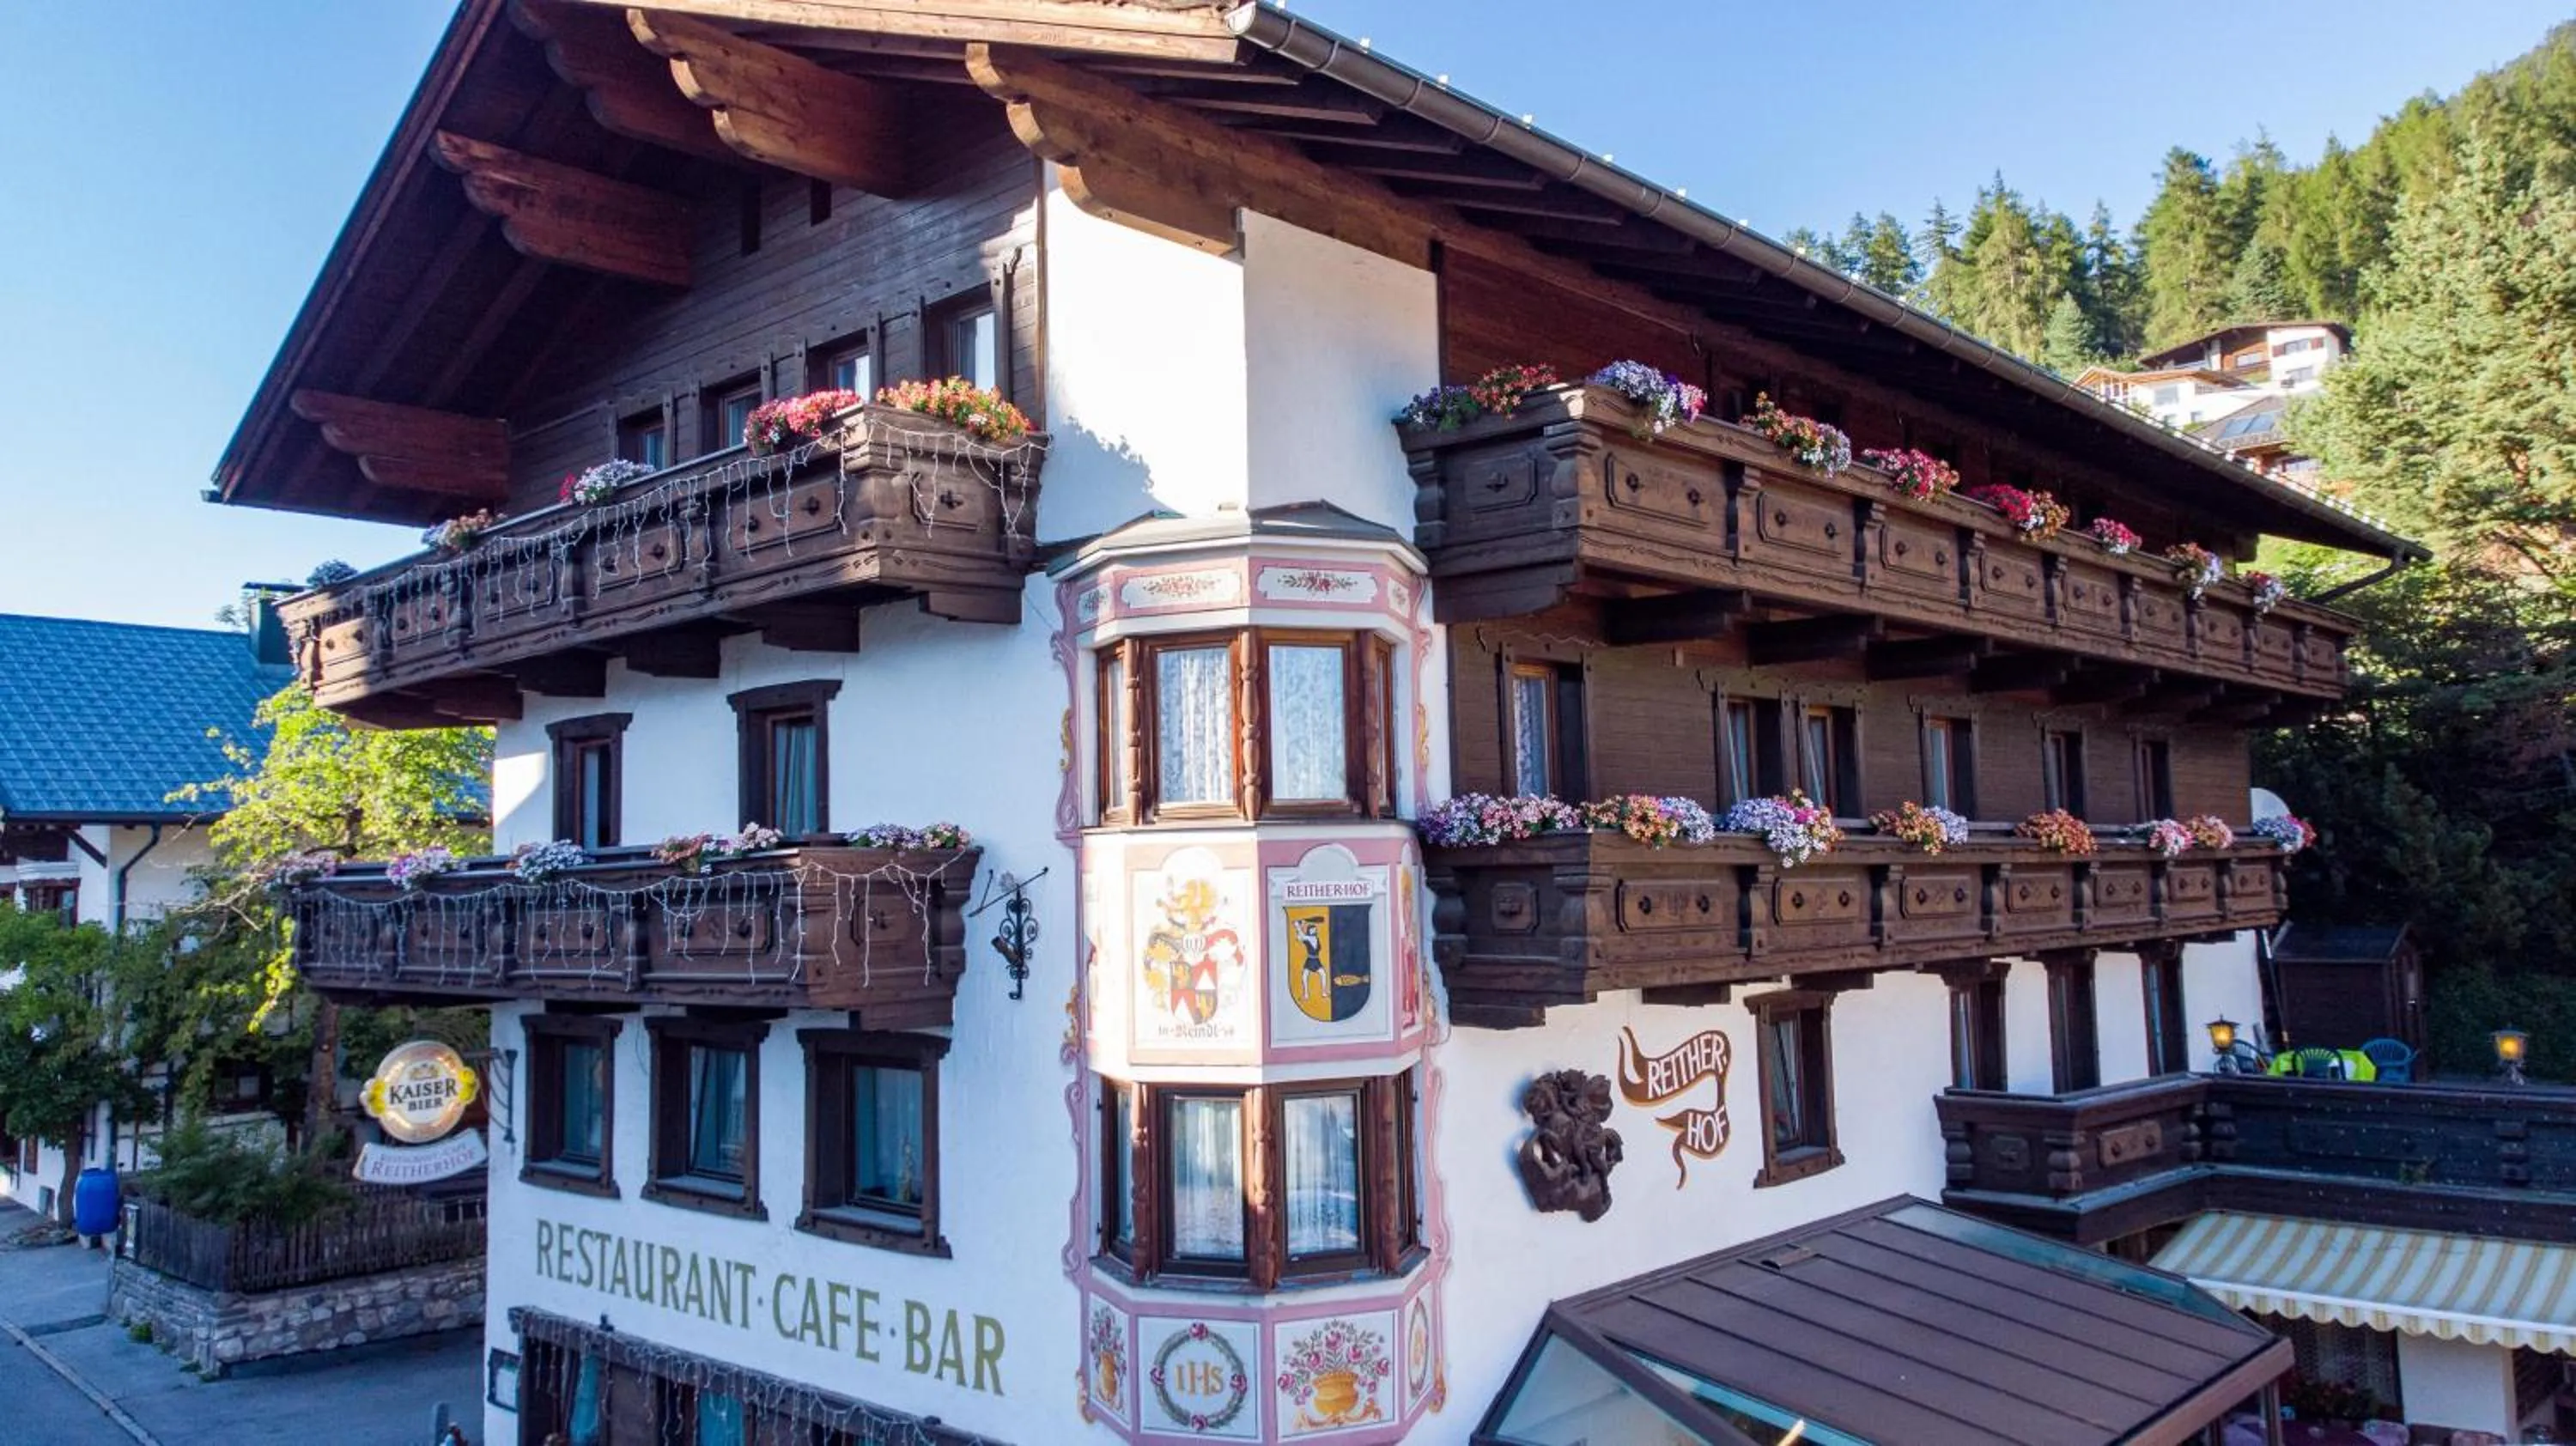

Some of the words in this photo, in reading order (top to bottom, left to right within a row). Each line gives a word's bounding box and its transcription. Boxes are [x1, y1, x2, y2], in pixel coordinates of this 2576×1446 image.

[390, 1078, 458, 1104] KAISER
[408, 1098, 442, 1110] BIER
[1686, 1105, 1728, 1152] HOF
[536, 1218, 756, 1329] RESTAURANT
[773, 1273, 880, 1363] CAFE
[904, 1298, 1005, 1396] BAR
[1176, 1361, 1224, 1395] IHS
